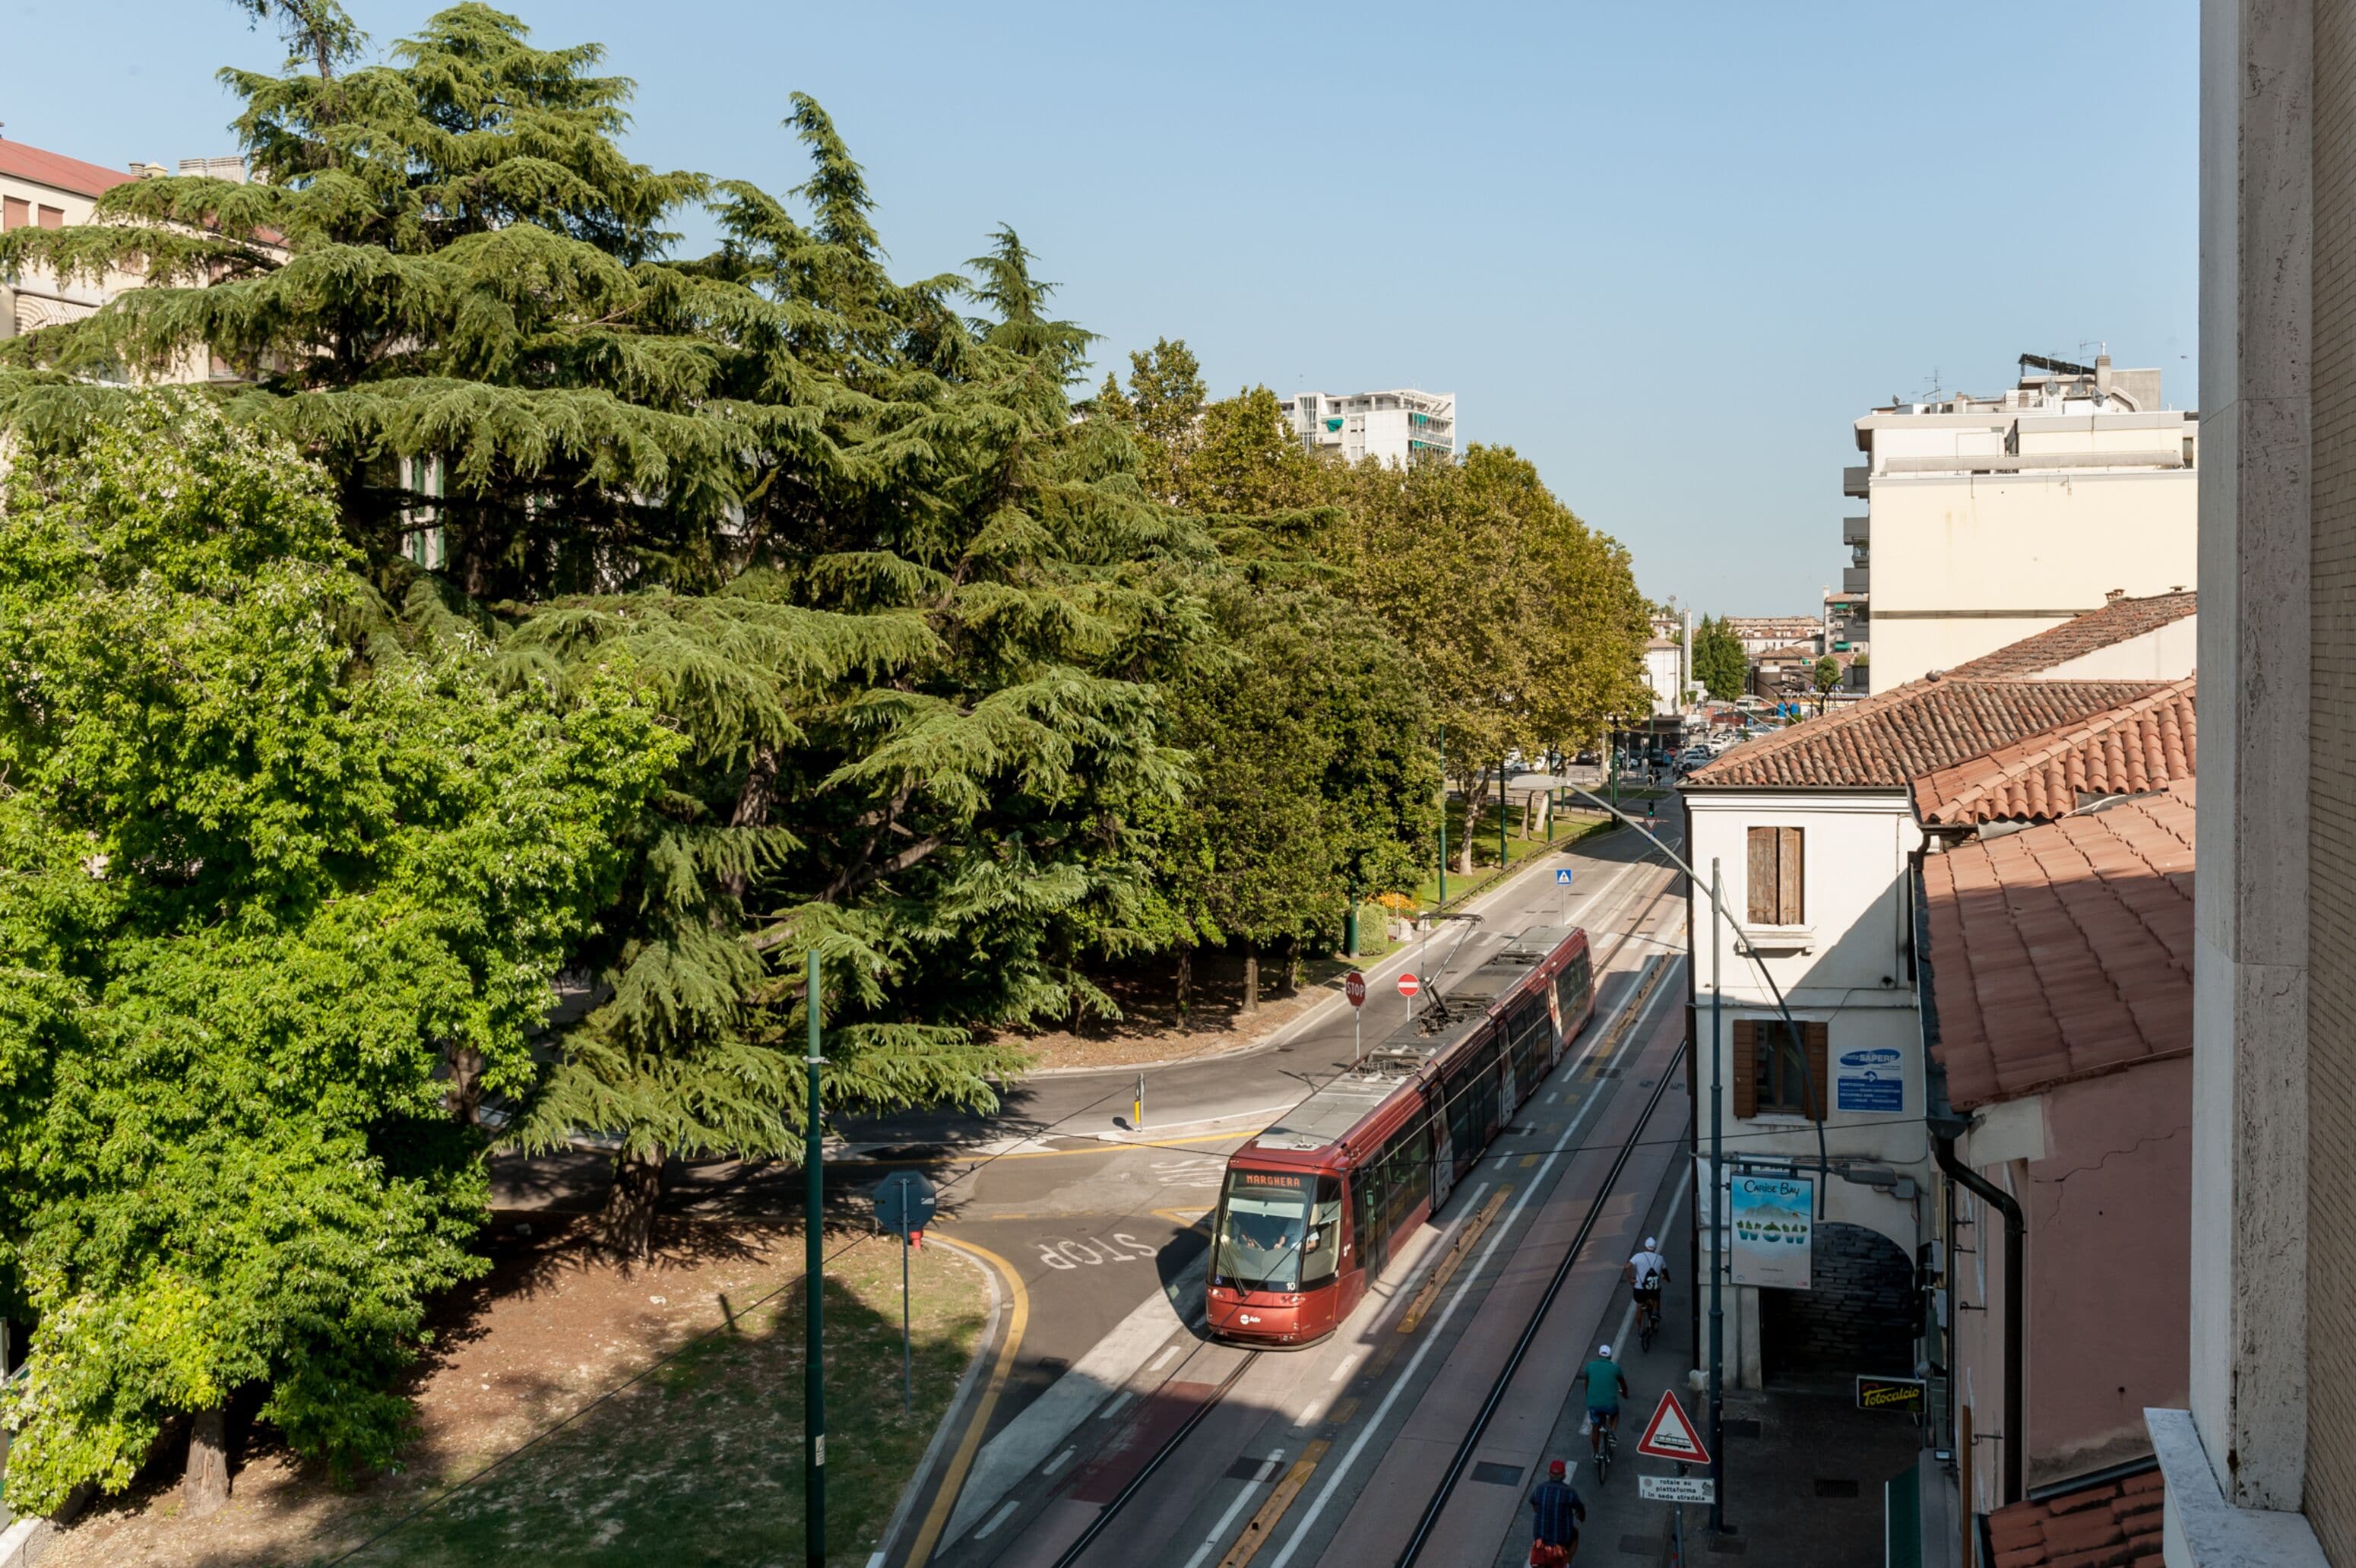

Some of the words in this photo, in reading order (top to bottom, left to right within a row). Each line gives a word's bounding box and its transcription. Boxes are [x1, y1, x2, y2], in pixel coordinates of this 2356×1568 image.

[1347, 981, 1364, 997] STOP
[1246, 1174, 1300, 1186] MARGHERA
[1737, 1221, 1807, 1244] WOW
[1038, 1234, 1157, 1269] STOP
[1286, 1282, 1295, 1291] 10
[1863, 1386, 1920, 1406] Totocalcio
